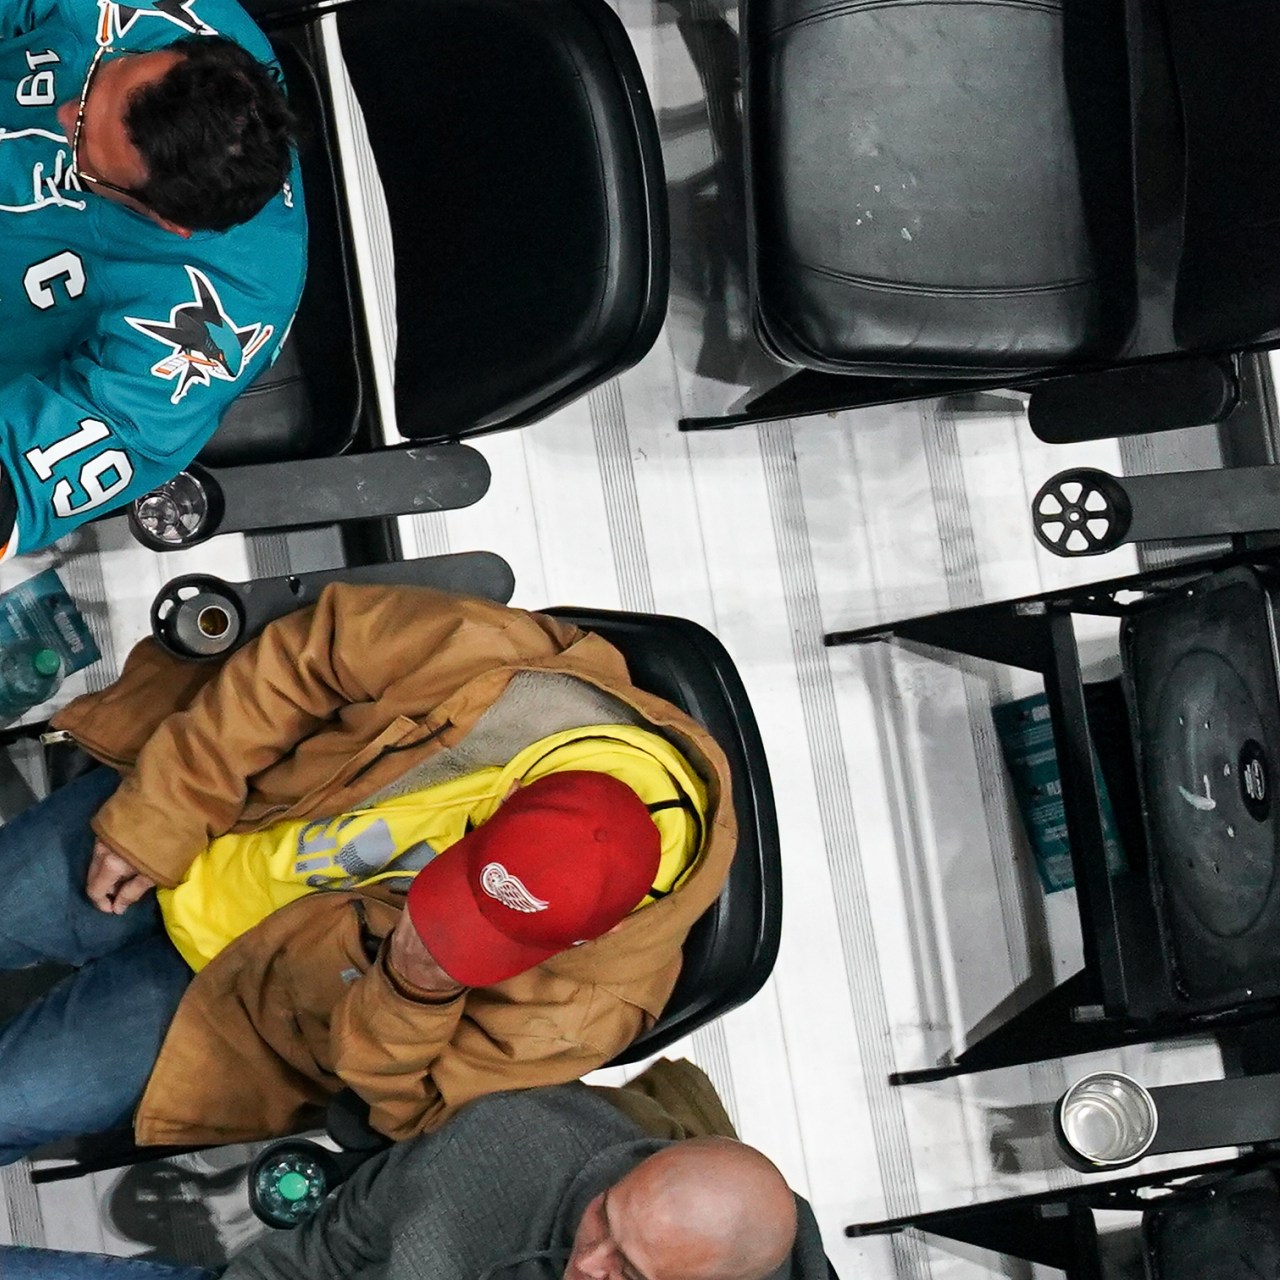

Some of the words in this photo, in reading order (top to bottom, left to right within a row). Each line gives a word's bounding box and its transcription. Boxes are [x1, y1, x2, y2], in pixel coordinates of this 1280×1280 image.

[16, 48, 61, 106] 19
[23, 250, 86, 309] C
[25, 418, 134, 518] 19
